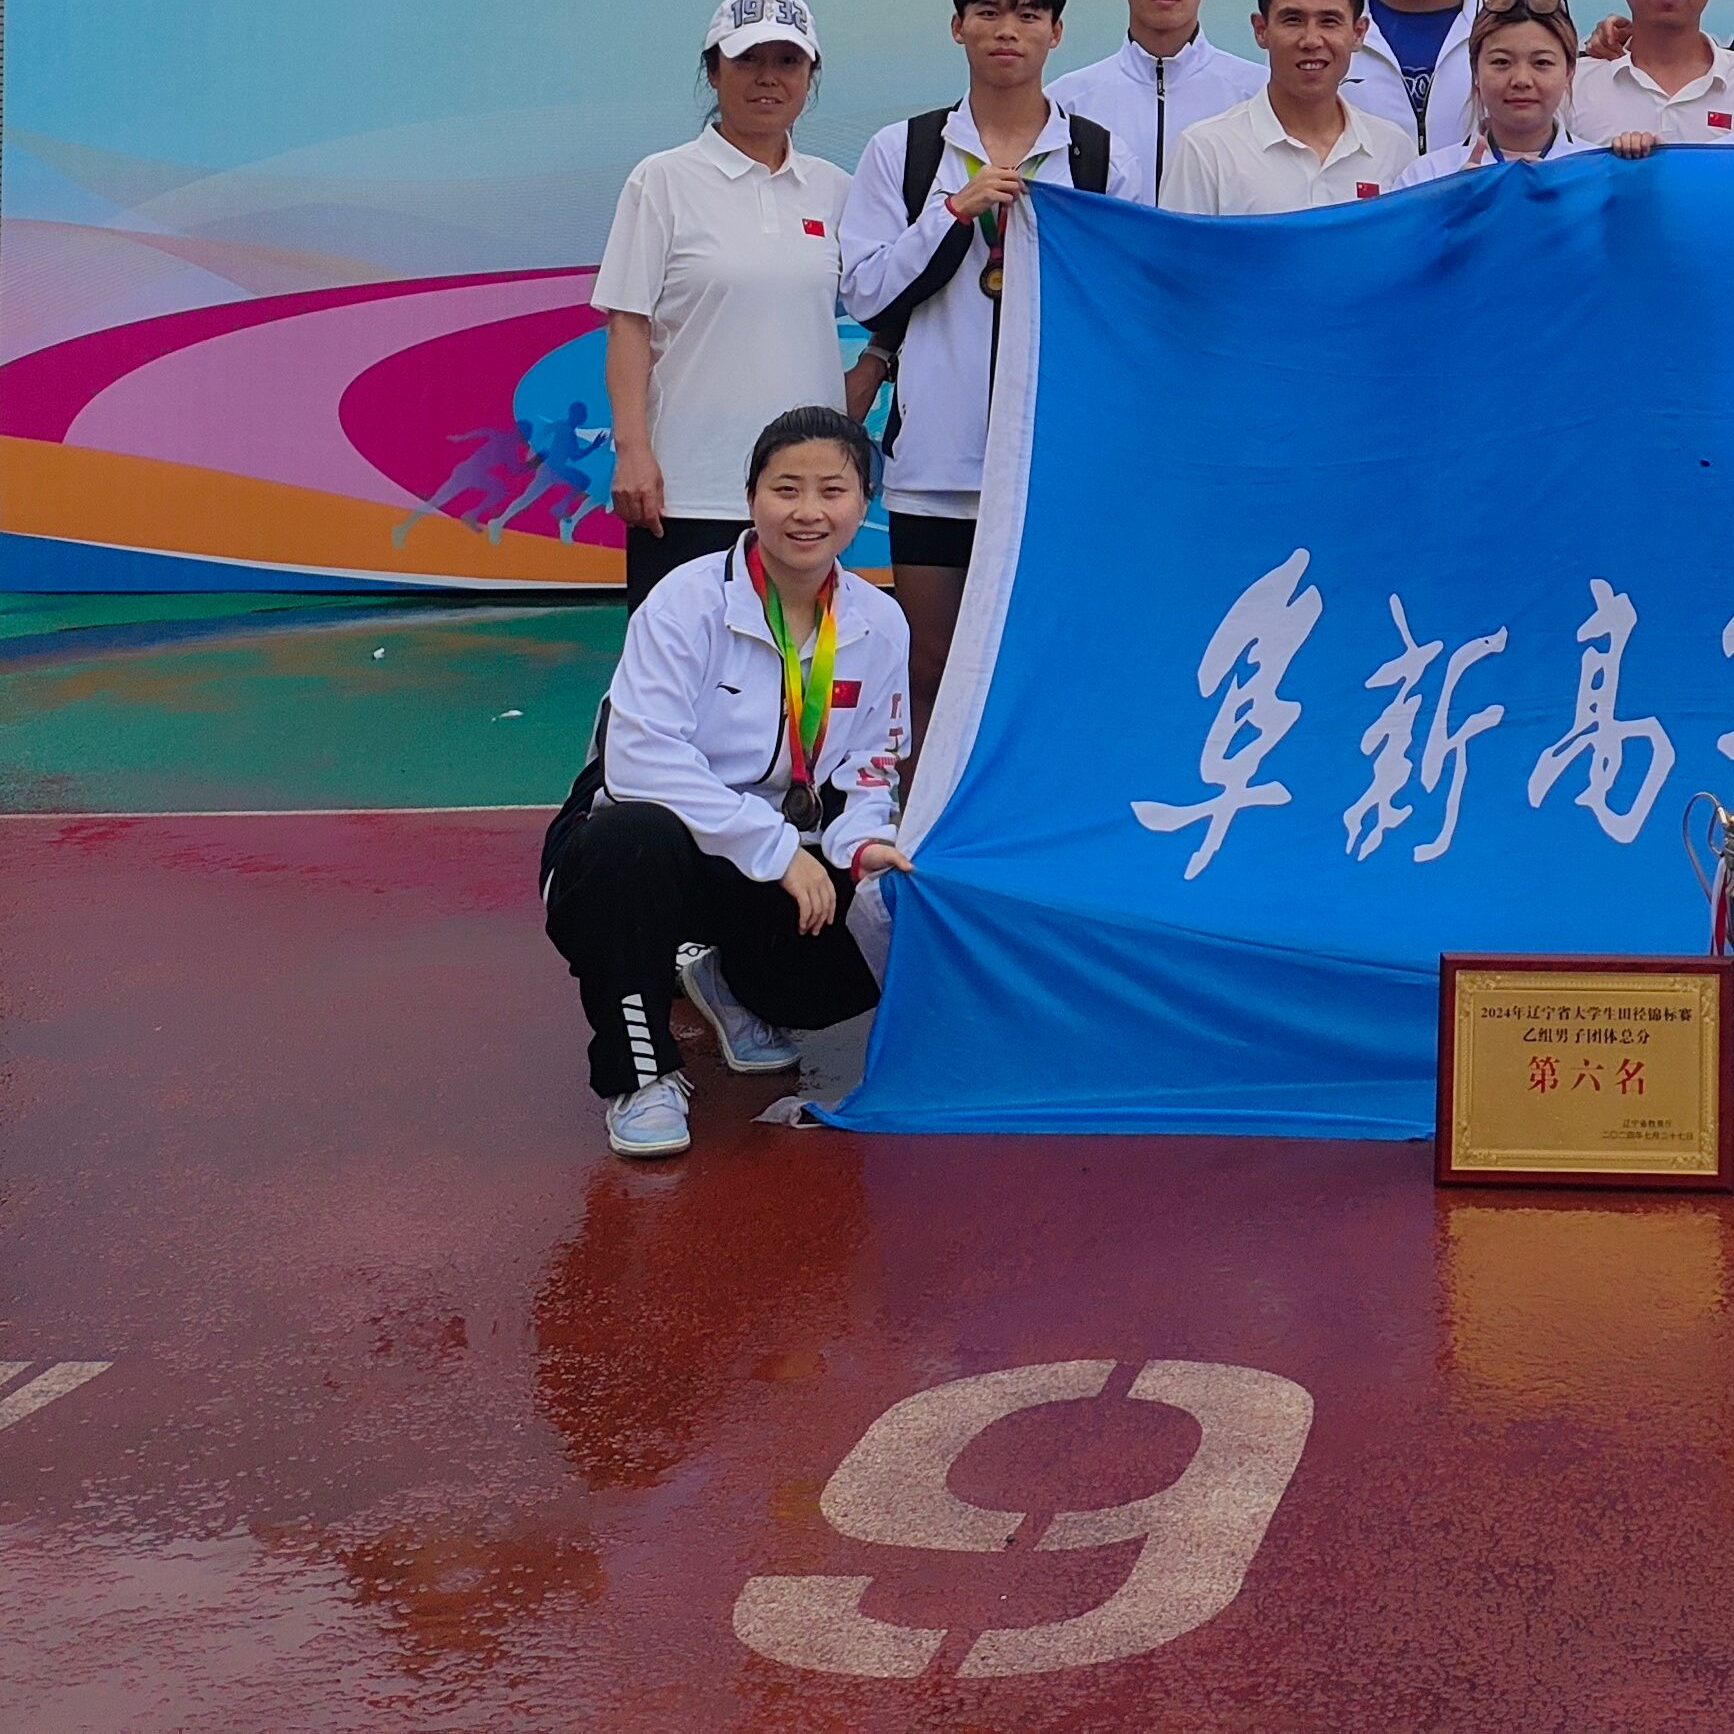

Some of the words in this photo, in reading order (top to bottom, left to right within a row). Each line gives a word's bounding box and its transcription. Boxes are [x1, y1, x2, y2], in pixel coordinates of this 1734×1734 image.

[1481, 1004, 1693, 1022] 2024年辽宁省大学生田径锦标赛
[1523, 1027, 1650, 1044] 乙组男子团体总分
[1527, 1055, 1646, 1095] 第六名
